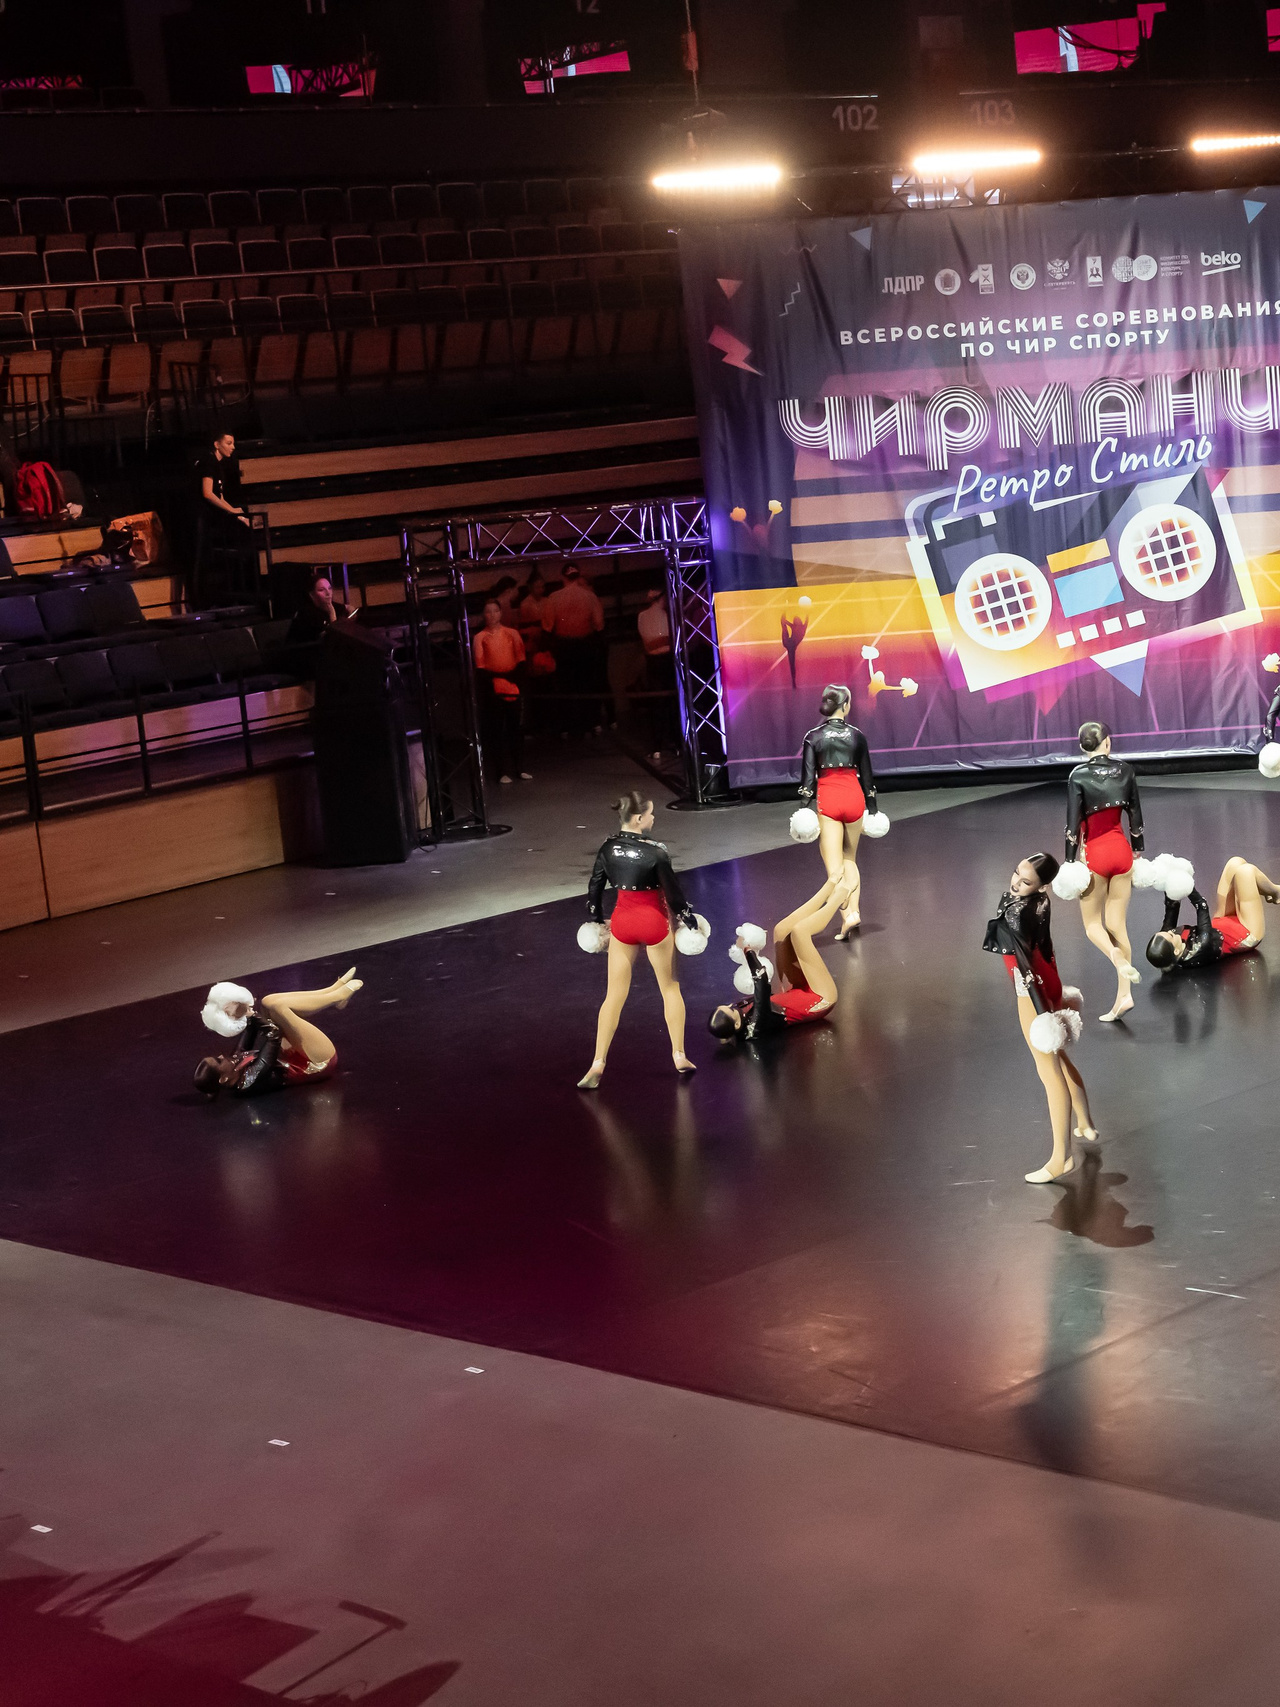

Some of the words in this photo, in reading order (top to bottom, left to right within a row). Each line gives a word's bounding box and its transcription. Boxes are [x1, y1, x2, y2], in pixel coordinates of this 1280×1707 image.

[832, 104, 880, 132] 102
[1200, 251, 1242, 267] beko
[882, 275, 925, 295] ЛДПР
[840, 315, 1063, 345] ВСЕРОССИЙСКИЕ
[960, 341, 995, 357] ПО
[1006, 337, 1057, 354] ЧИР
[1069, 329, 1170, 350] СПОРТУ
[953, 464, 1073, 513] Ретро
[1091, 435, 1213, 484] Стиль
